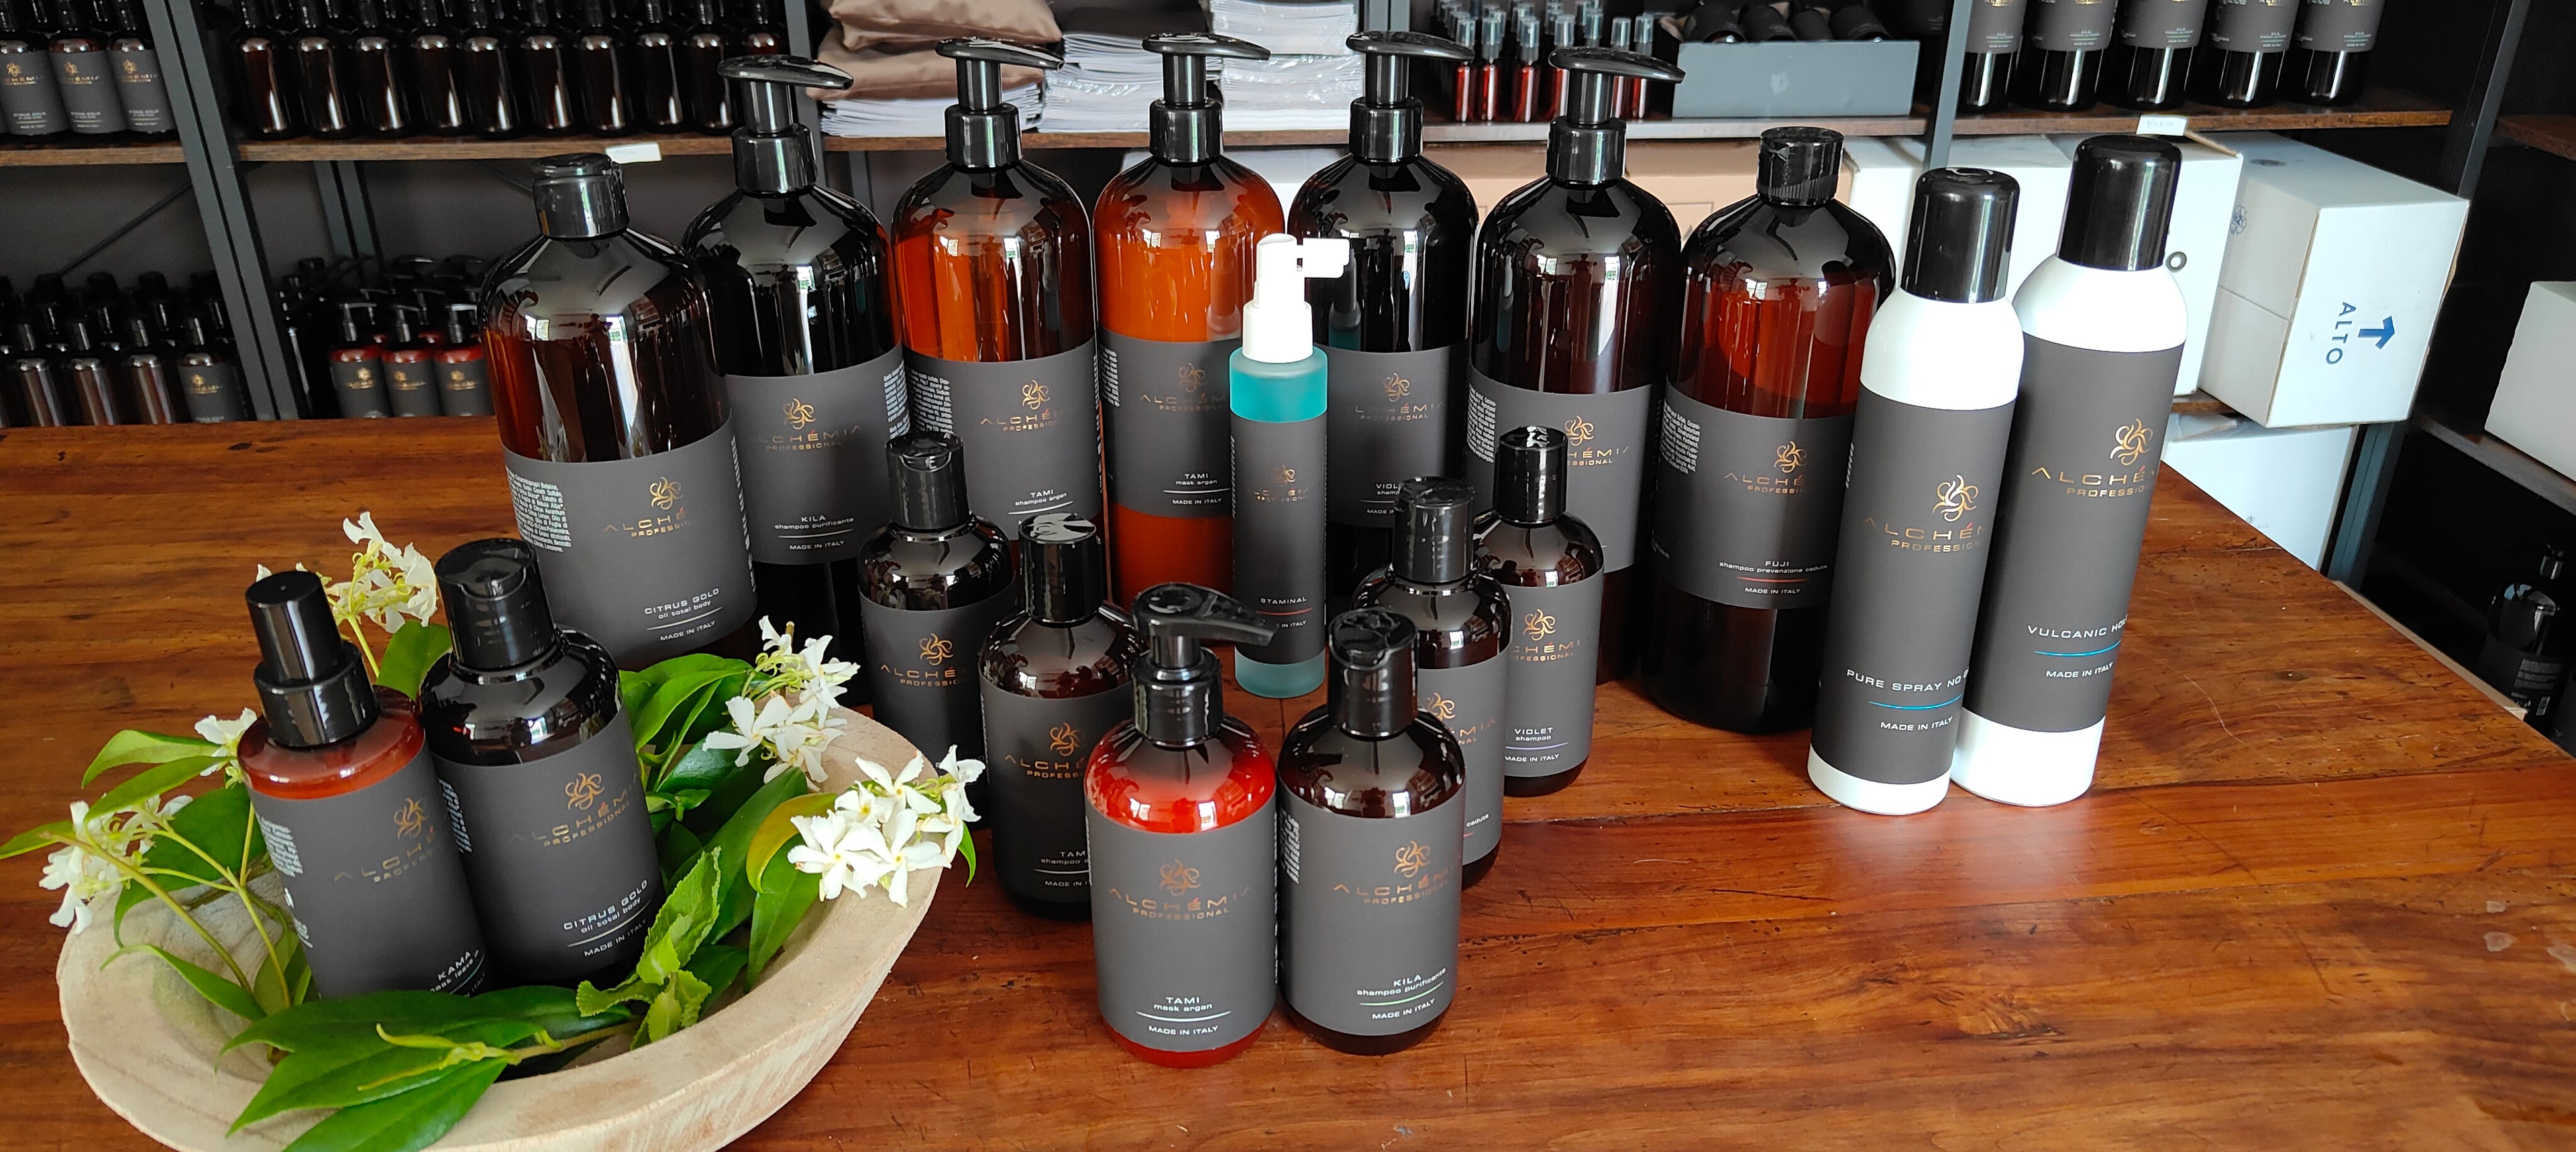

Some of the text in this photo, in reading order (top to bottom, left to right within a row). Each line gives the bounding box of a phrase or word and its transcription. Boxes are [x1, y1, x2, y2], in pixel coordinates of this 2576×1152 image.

[2326, 302, 2357, 365] ALTO
[1140, 393, 1226, 404] ALCHÉM
[1725, 472, 1803, 485] ALCHÉ
[1015, 493, 1067, 506] shampoo argan
[1030, 489, 1054, 498] TAMI
[801, 514, 826, 522] KILA
[812, 516, 854, 528] purificante
[824, 540, 845, 548] ITALY
[1719, 562, 1754, 572] shampoo
[1805, 563, 1827, 572] caduta
[645, 587, 719, 615] CITRUS GOLD
[1260, 596, 1307, 605] STAMINAL
[672, 606, 692, 617] total
[694, 600, 711, 612] body
[660, 632, 684, 642] MADE
[697, 620, 716, 631] ITALY
[2027, 614, 2128, 639] VULCANIC HOL
[881, 665, 956, 678] ALCHÉ
[2045, 670, 2078, 679] MADE
[2094, 662, 2113, 674] ITALY
[1846, 669, 1884, 688] PURE
[1892, 682, 1943, 692] SPRAY
[1947, 675, 1962, 689] NO
[1880, 716, 1953, 731] MADE IN ITALY
[1514, 727, 1554, 735] VIOLET
[1540, 754, 1560, 762] ITALY
[1466, 813, 1489, 827] caduta
[564, 880, 647, 930] CITRUS GOLD
[1110, 886, 1252, 911] ALCHÉMIA
[581, 897, 641, 933] oil total body
[1133, 908, 1229, 921] PROFESSIONAL
[584, 919, 646, 957] MADE IN ITALY
[438, 952, 470, 981] KAMA
[1357, 968, 1446, 996] shampoo purificante
[1394, 974, 1421, 986] KILA
[1166, 996, 1200, 1004] TAMI
[1153, 1004, 1213, 1013] mask argan
[1372, 1011, 1400, 1019] MADE
[1415, 998, 1435, 1012] ITALY
[1148, 1025, 1176, 1035] MADE
[1193, 1025, 1219, 1035] ITALY
